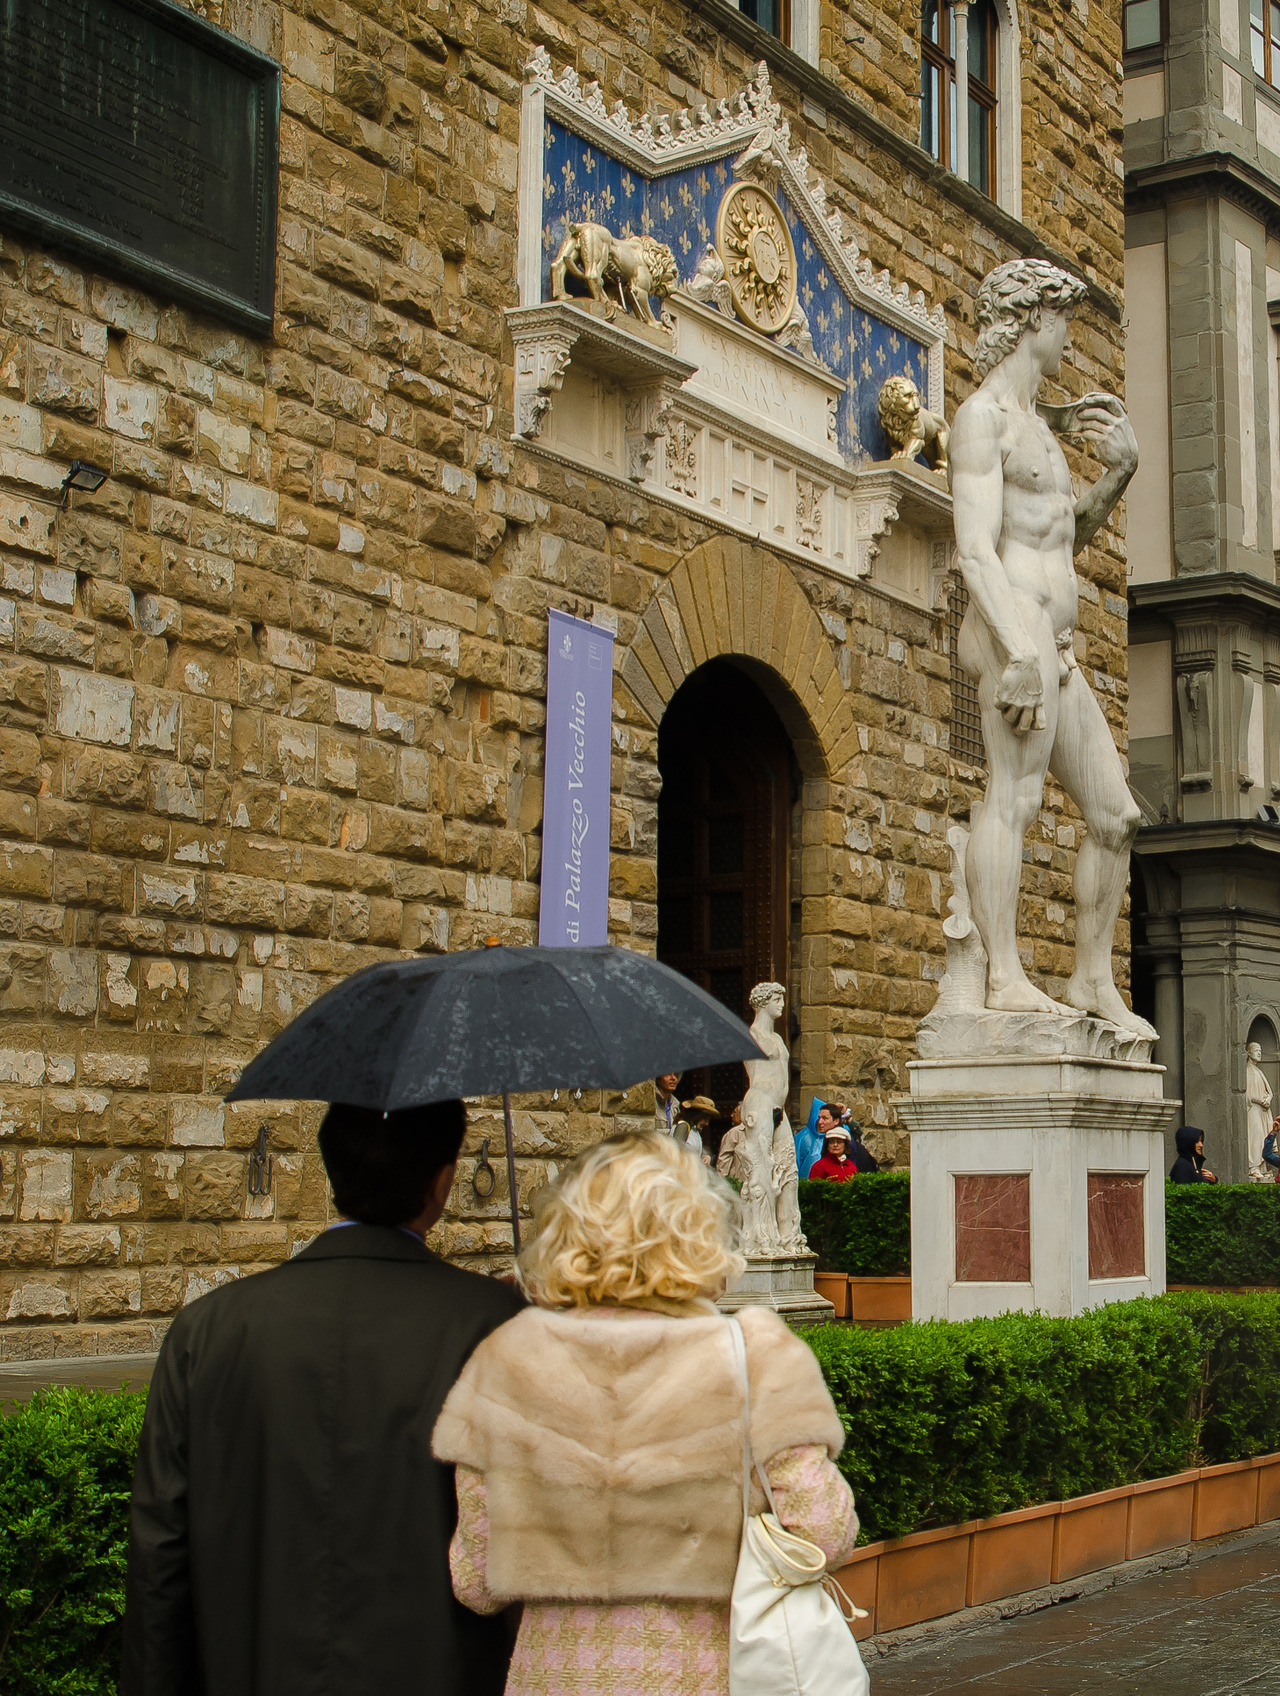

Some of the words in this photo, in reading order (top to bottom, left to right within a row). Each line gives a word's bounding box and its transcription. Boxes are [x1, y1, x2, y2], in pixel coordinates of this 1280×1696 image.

[568, 690, 586, 791] Vecchio
[565, 798, 589, 913] Palazzo
[566, 920, 580, 944] di
